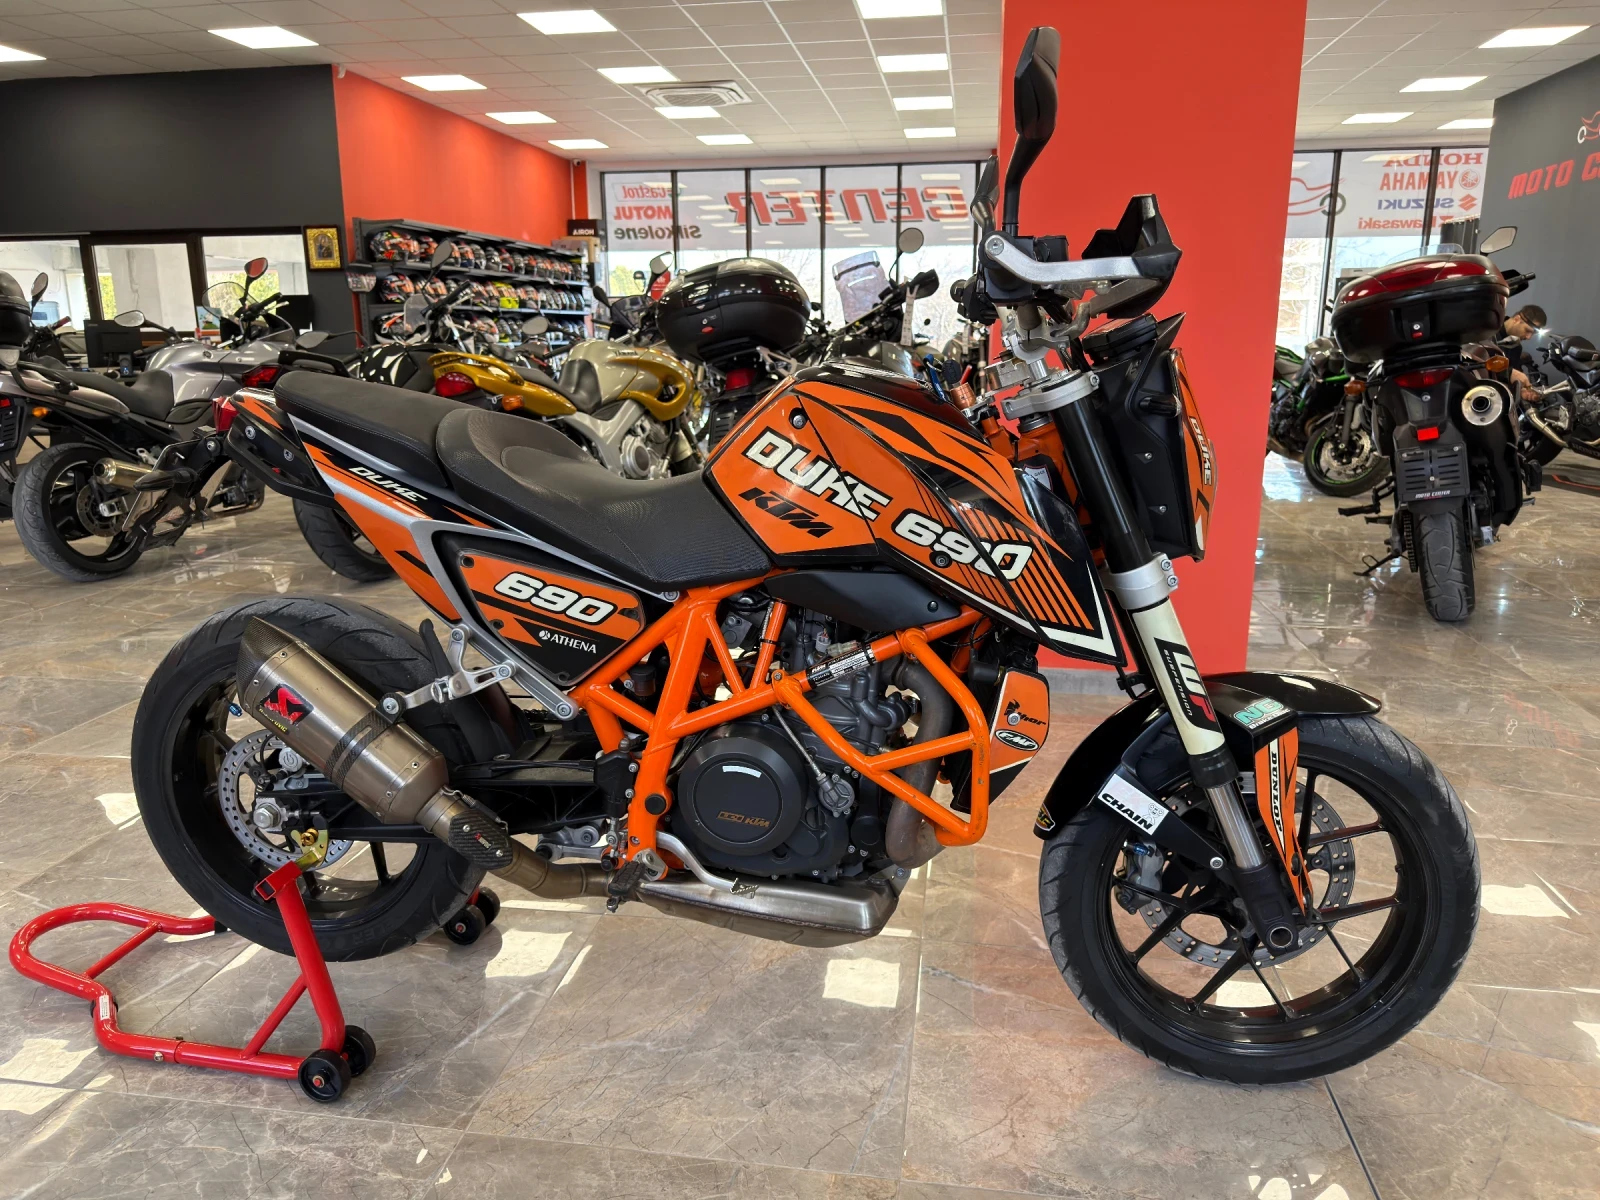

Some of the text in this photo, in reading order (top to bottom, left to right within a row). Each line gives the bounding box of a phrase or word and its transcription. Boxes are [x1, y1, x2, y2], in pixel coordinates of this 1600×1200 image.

[1508, 160, 1574, 199] MOTO
[349, 466, 428, 502] DUKE
[744, 428, 892, 522] DUKE
[738, 487, 834, 537] KTM
[892, 510, 1033, 580] 690
[494, 572, 615, 624] 690
[550, 633, 597, 654] ATHENA
[1234, 698, 1284, 726] NG
[1101, 792, 1154, 831] CHAIN
[1270, 750, 1284, 832] DUNLOP
